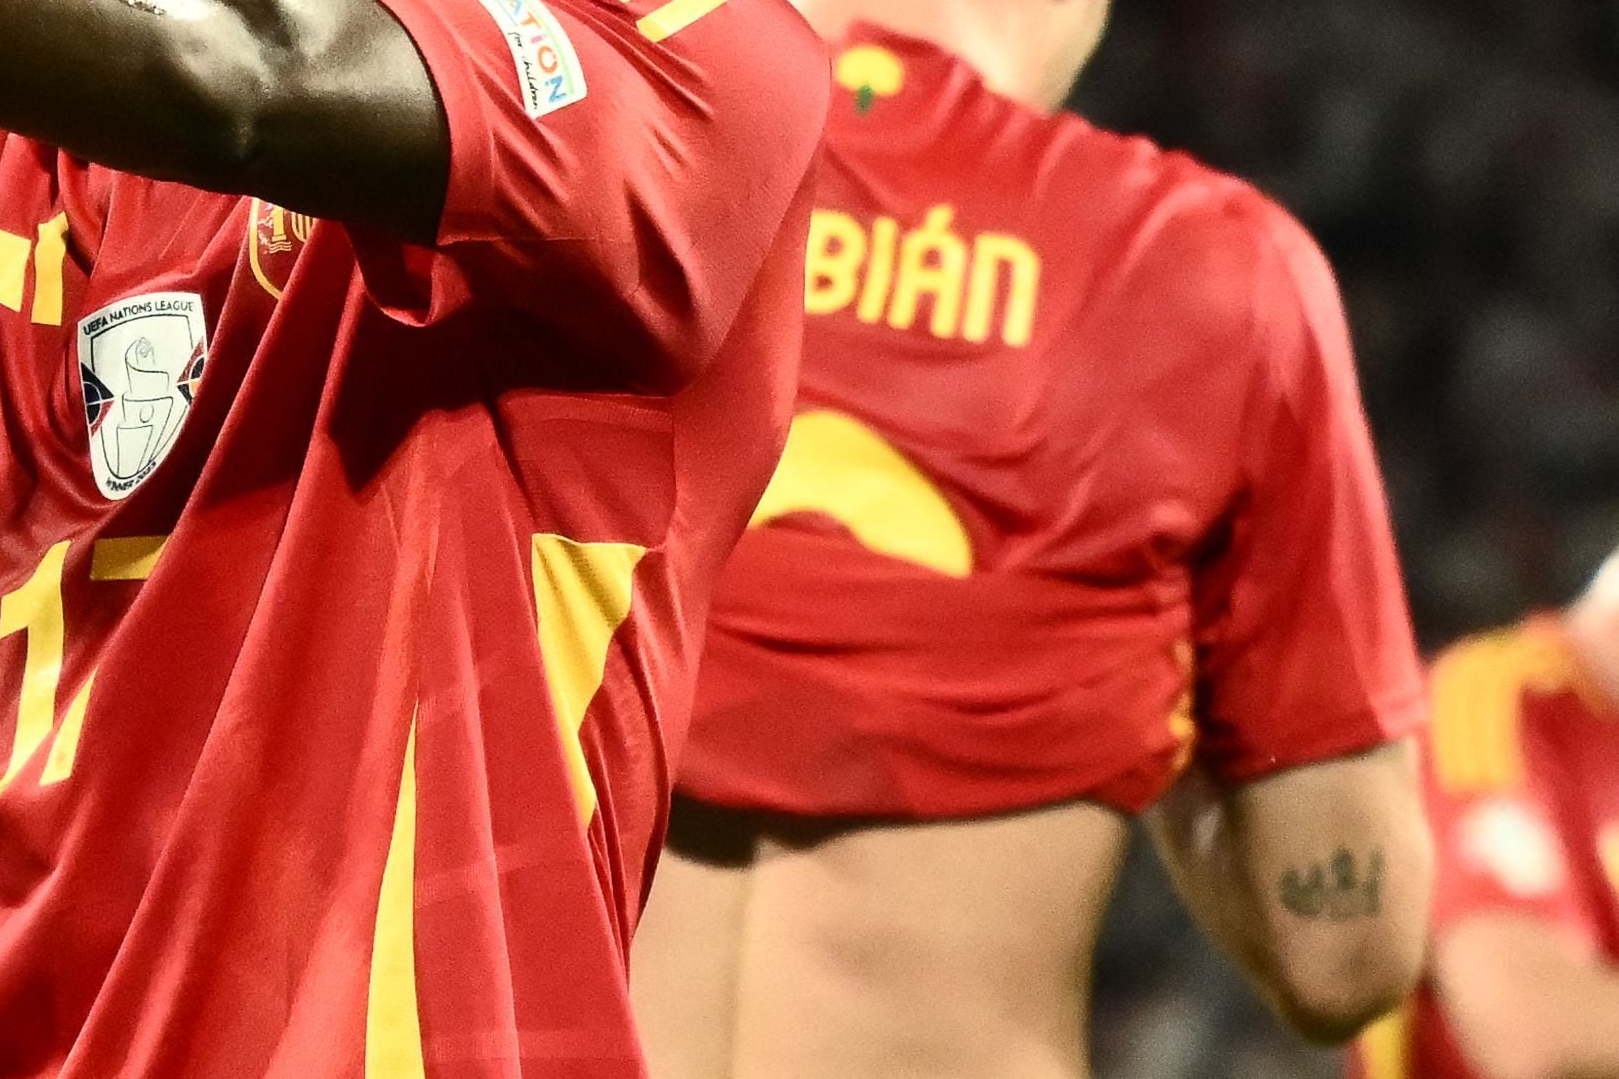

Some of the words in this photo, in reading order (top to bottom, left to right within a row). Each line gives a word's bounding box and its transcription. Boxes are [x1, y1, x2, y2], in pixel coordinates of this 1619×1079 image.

[83, 316, 109, 336] UEFA
[109, 301, 153, 322] NATIONS
[154, 300, 194, 312] LEAGUE
[803, 203, 1041, 349] BIÁN
